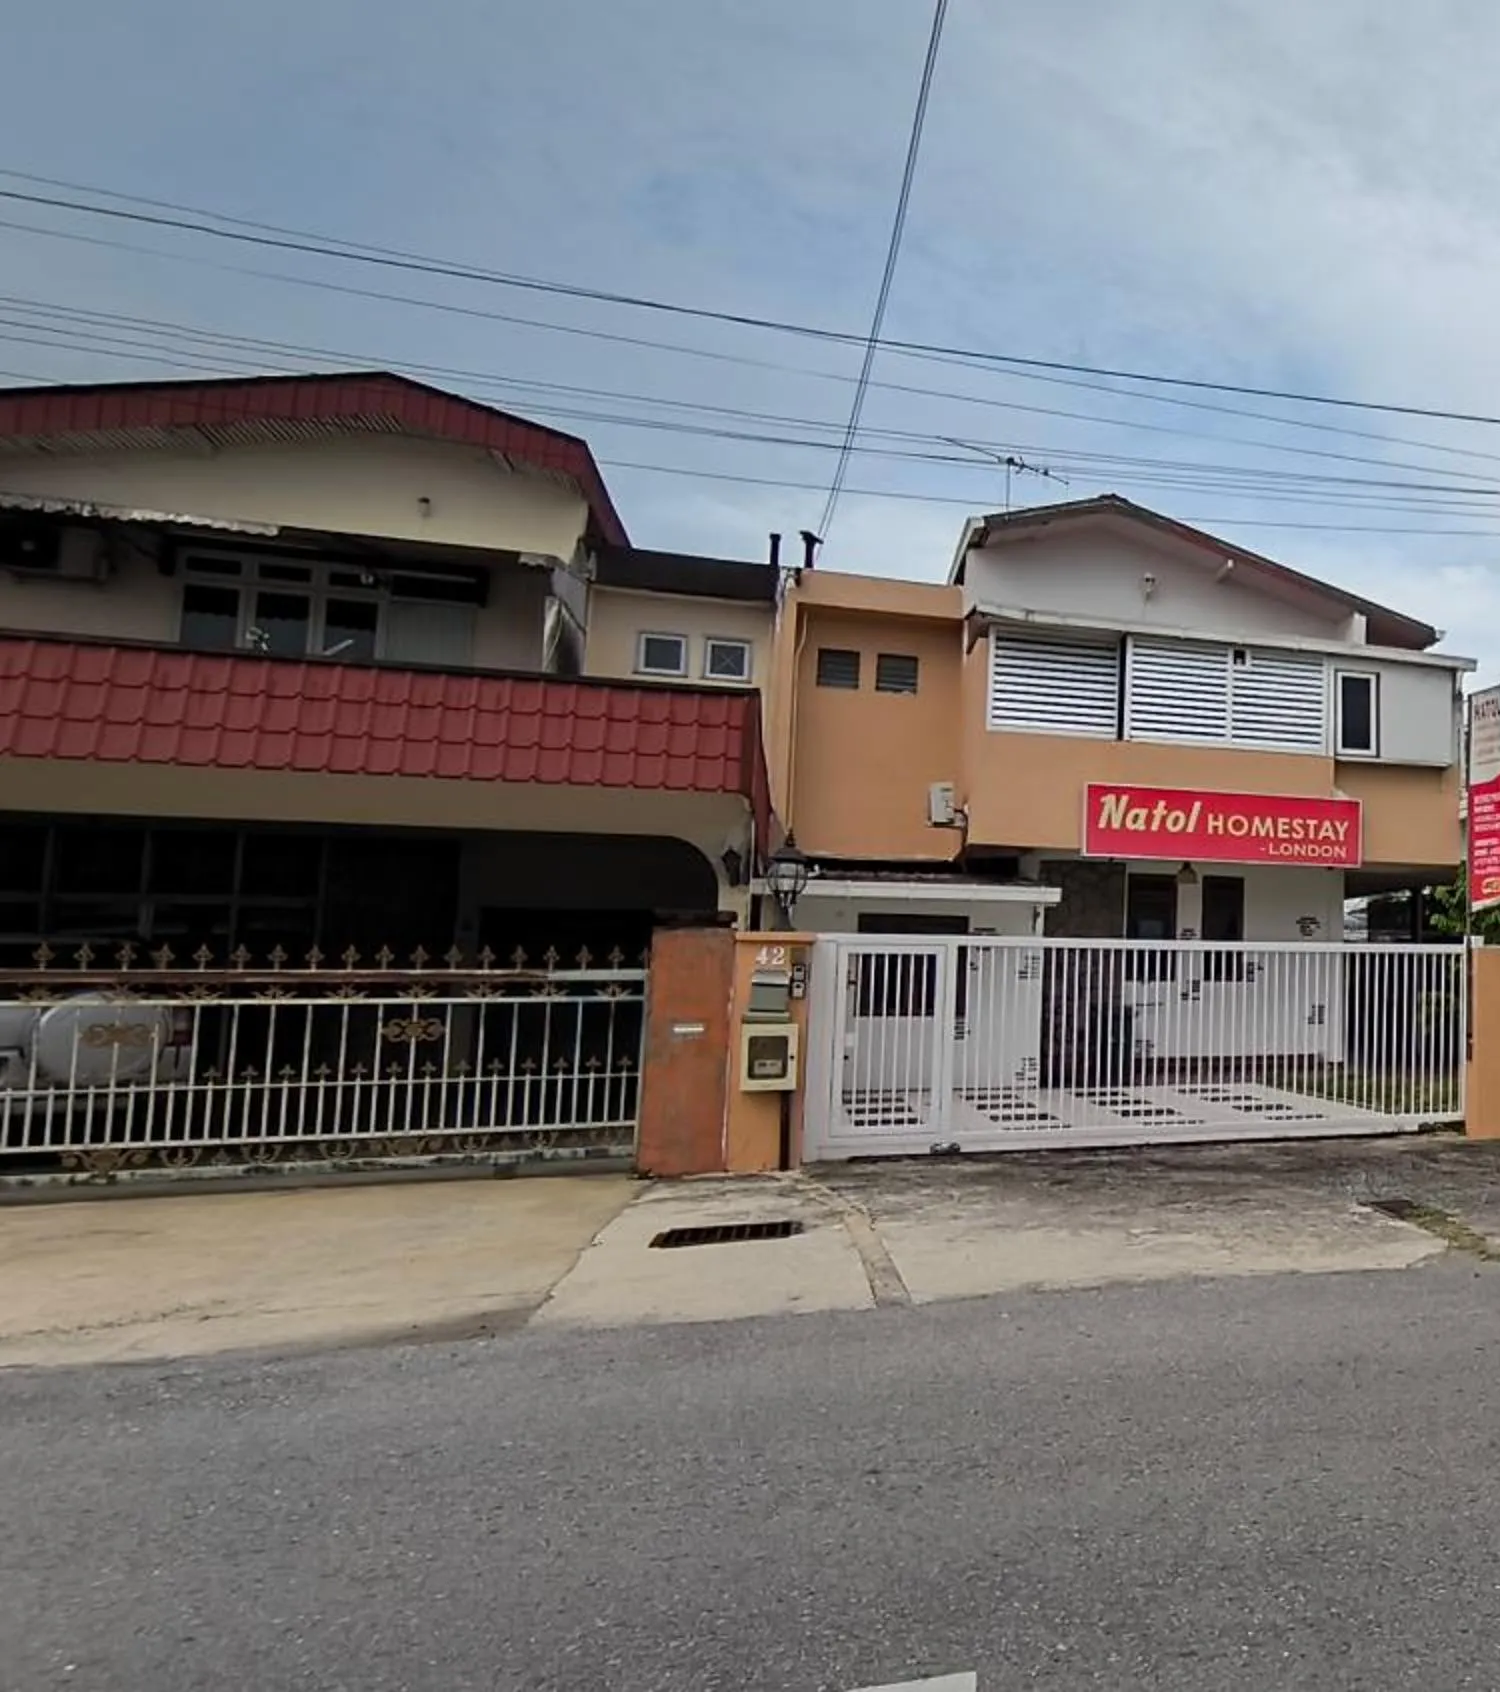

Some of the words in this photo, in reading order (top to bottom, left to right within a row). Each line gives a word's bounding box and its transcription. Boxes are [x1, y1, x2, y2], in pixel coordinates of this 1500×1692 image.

[1099, 794, 1202, 833] Natol
[1207, 813, 1349, 841] HOMESTAY
[756, 946, 785, 965] 42
